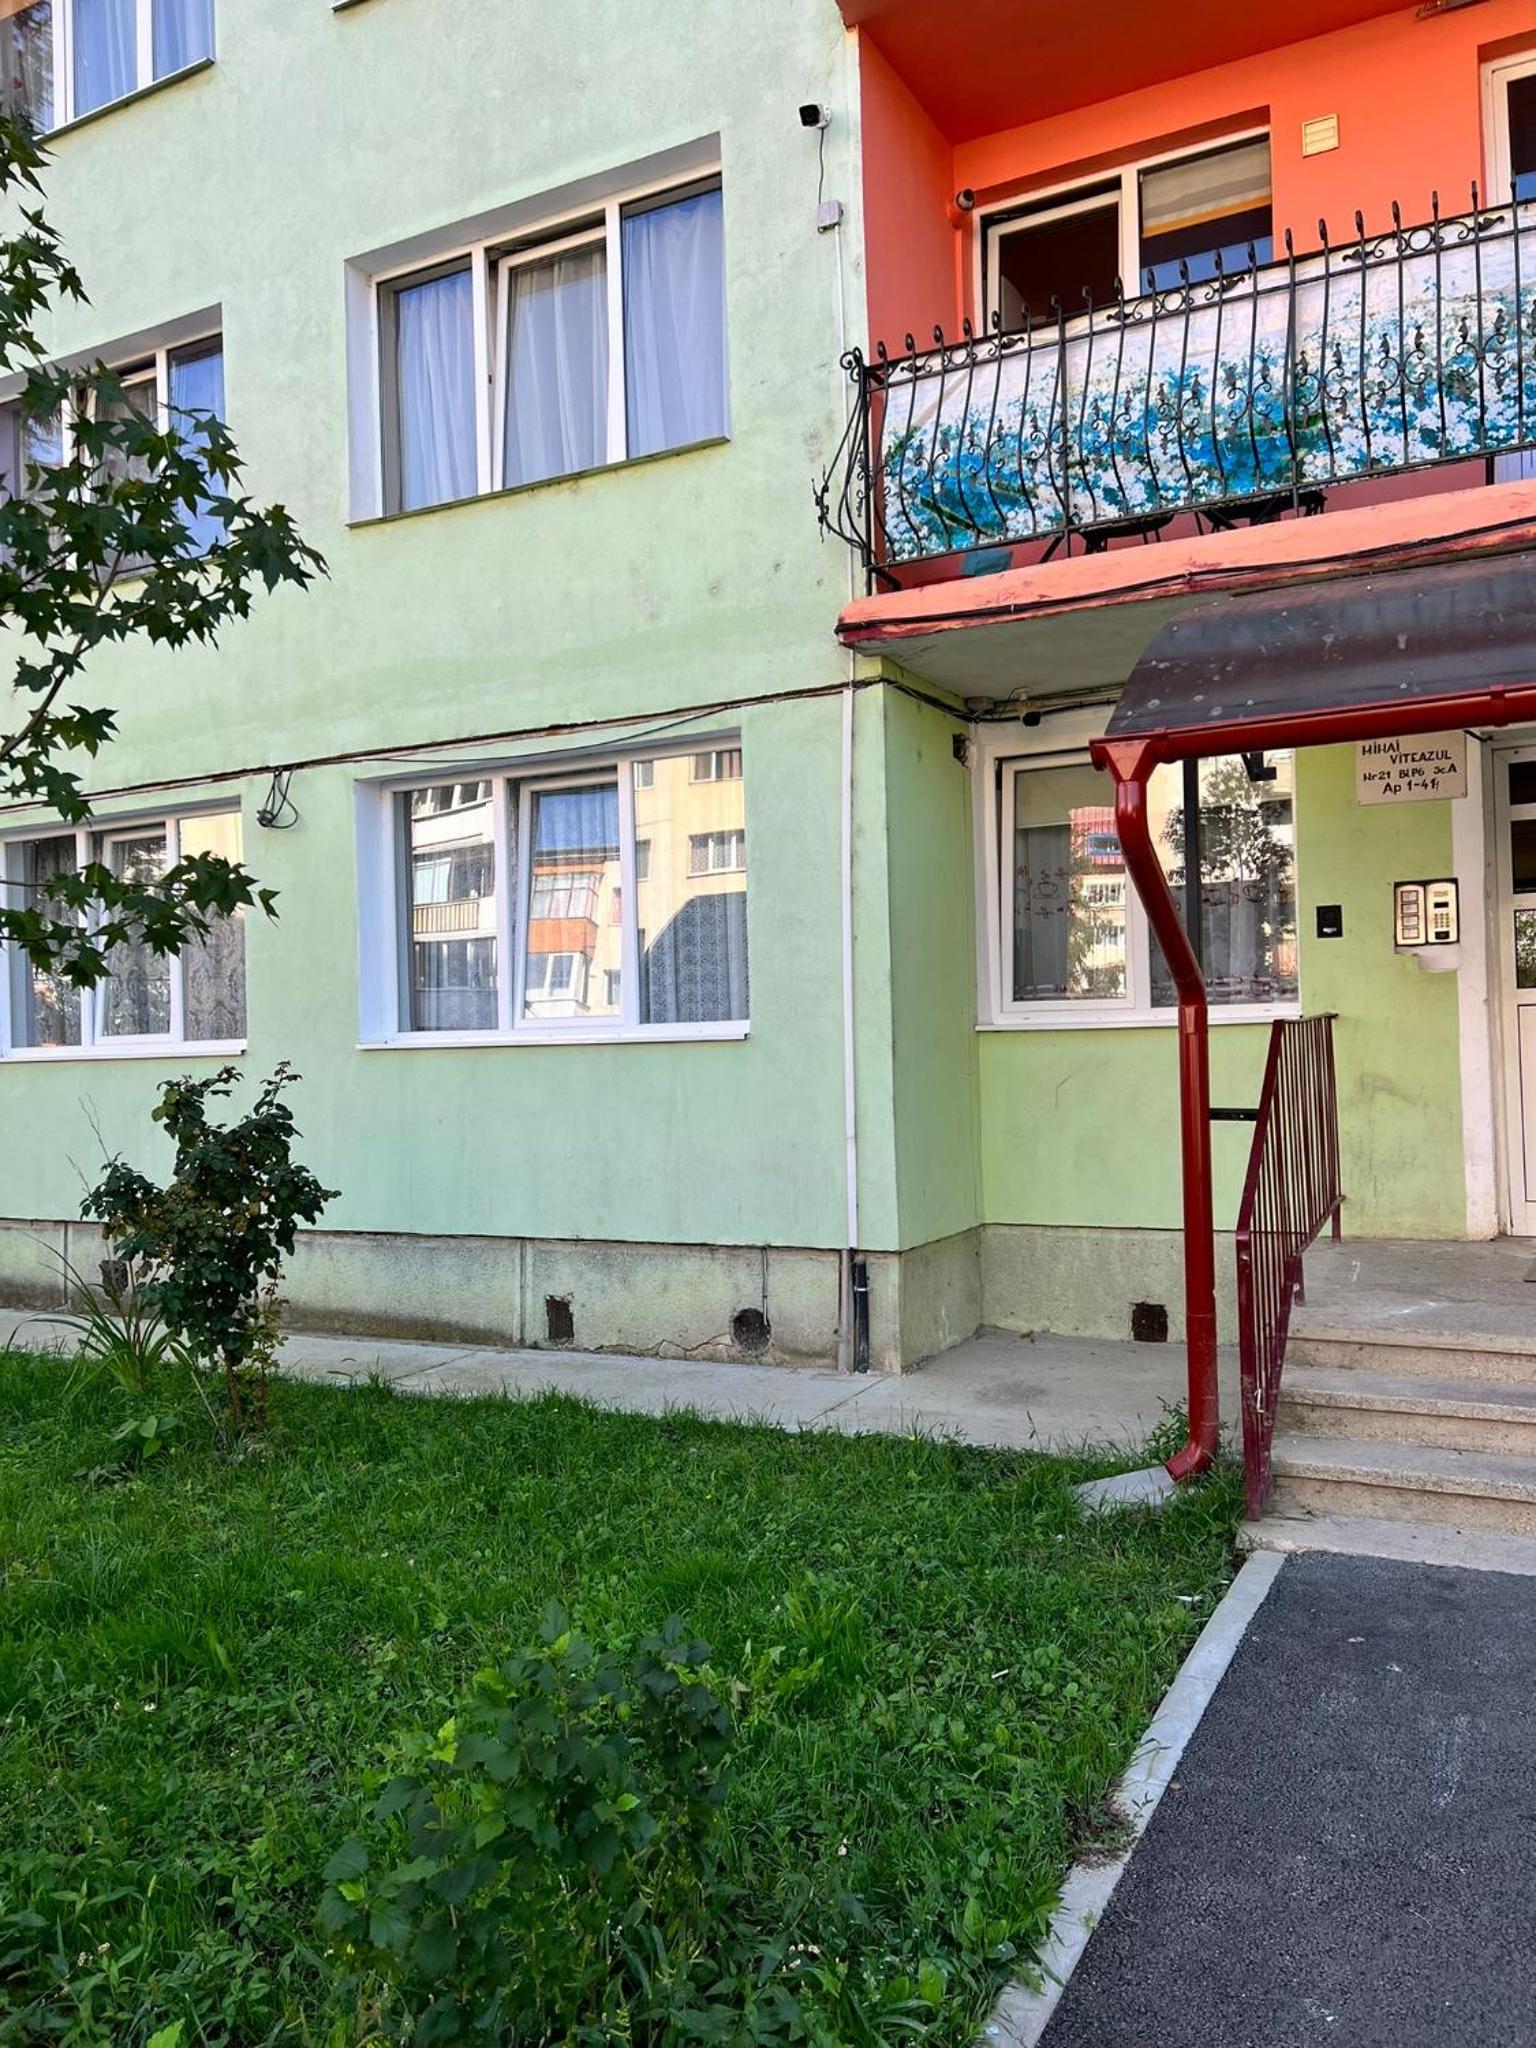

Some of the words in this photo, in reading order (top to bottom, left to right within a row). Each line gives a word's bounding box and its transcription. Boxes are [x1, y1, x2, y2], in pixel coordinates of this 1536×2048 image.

[1362, 740, 1400, 756] MIHAI
[1390, 750, 1452, 764] VITEAZUL
[1382, 782, 1402, 795] Ap
